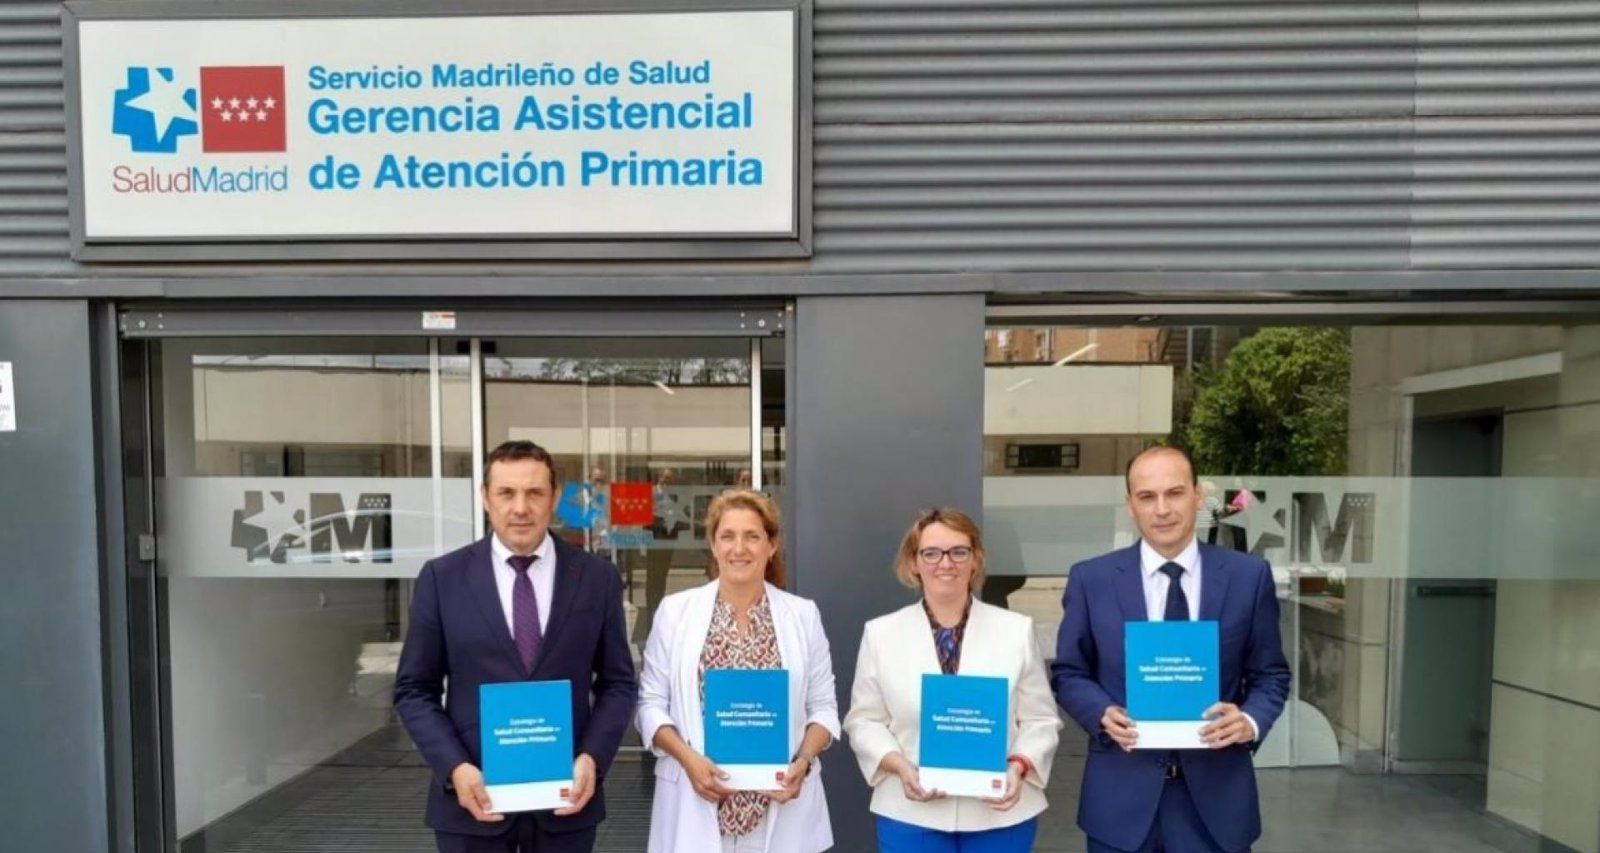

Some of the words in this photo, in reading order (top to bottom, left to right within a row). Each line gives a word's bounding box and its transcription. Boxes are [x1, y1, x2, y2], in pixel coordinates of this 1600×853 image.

[308, 66, 422, 90] Servicio
[431, 64, 575, 89] Madrileño
[584, 63, 620, 86] de
[629, 60, 711, 85] Salud
[307, 96, 501, 136] Gerencia
[514, 92, 753, 132] Asistencial
[112, 165, 288, 194] SaludMadrid
[308, 154, 361, 191] de
[374, 153, 566, 190] Atención
[581, 150, 763, 187] Primaria
